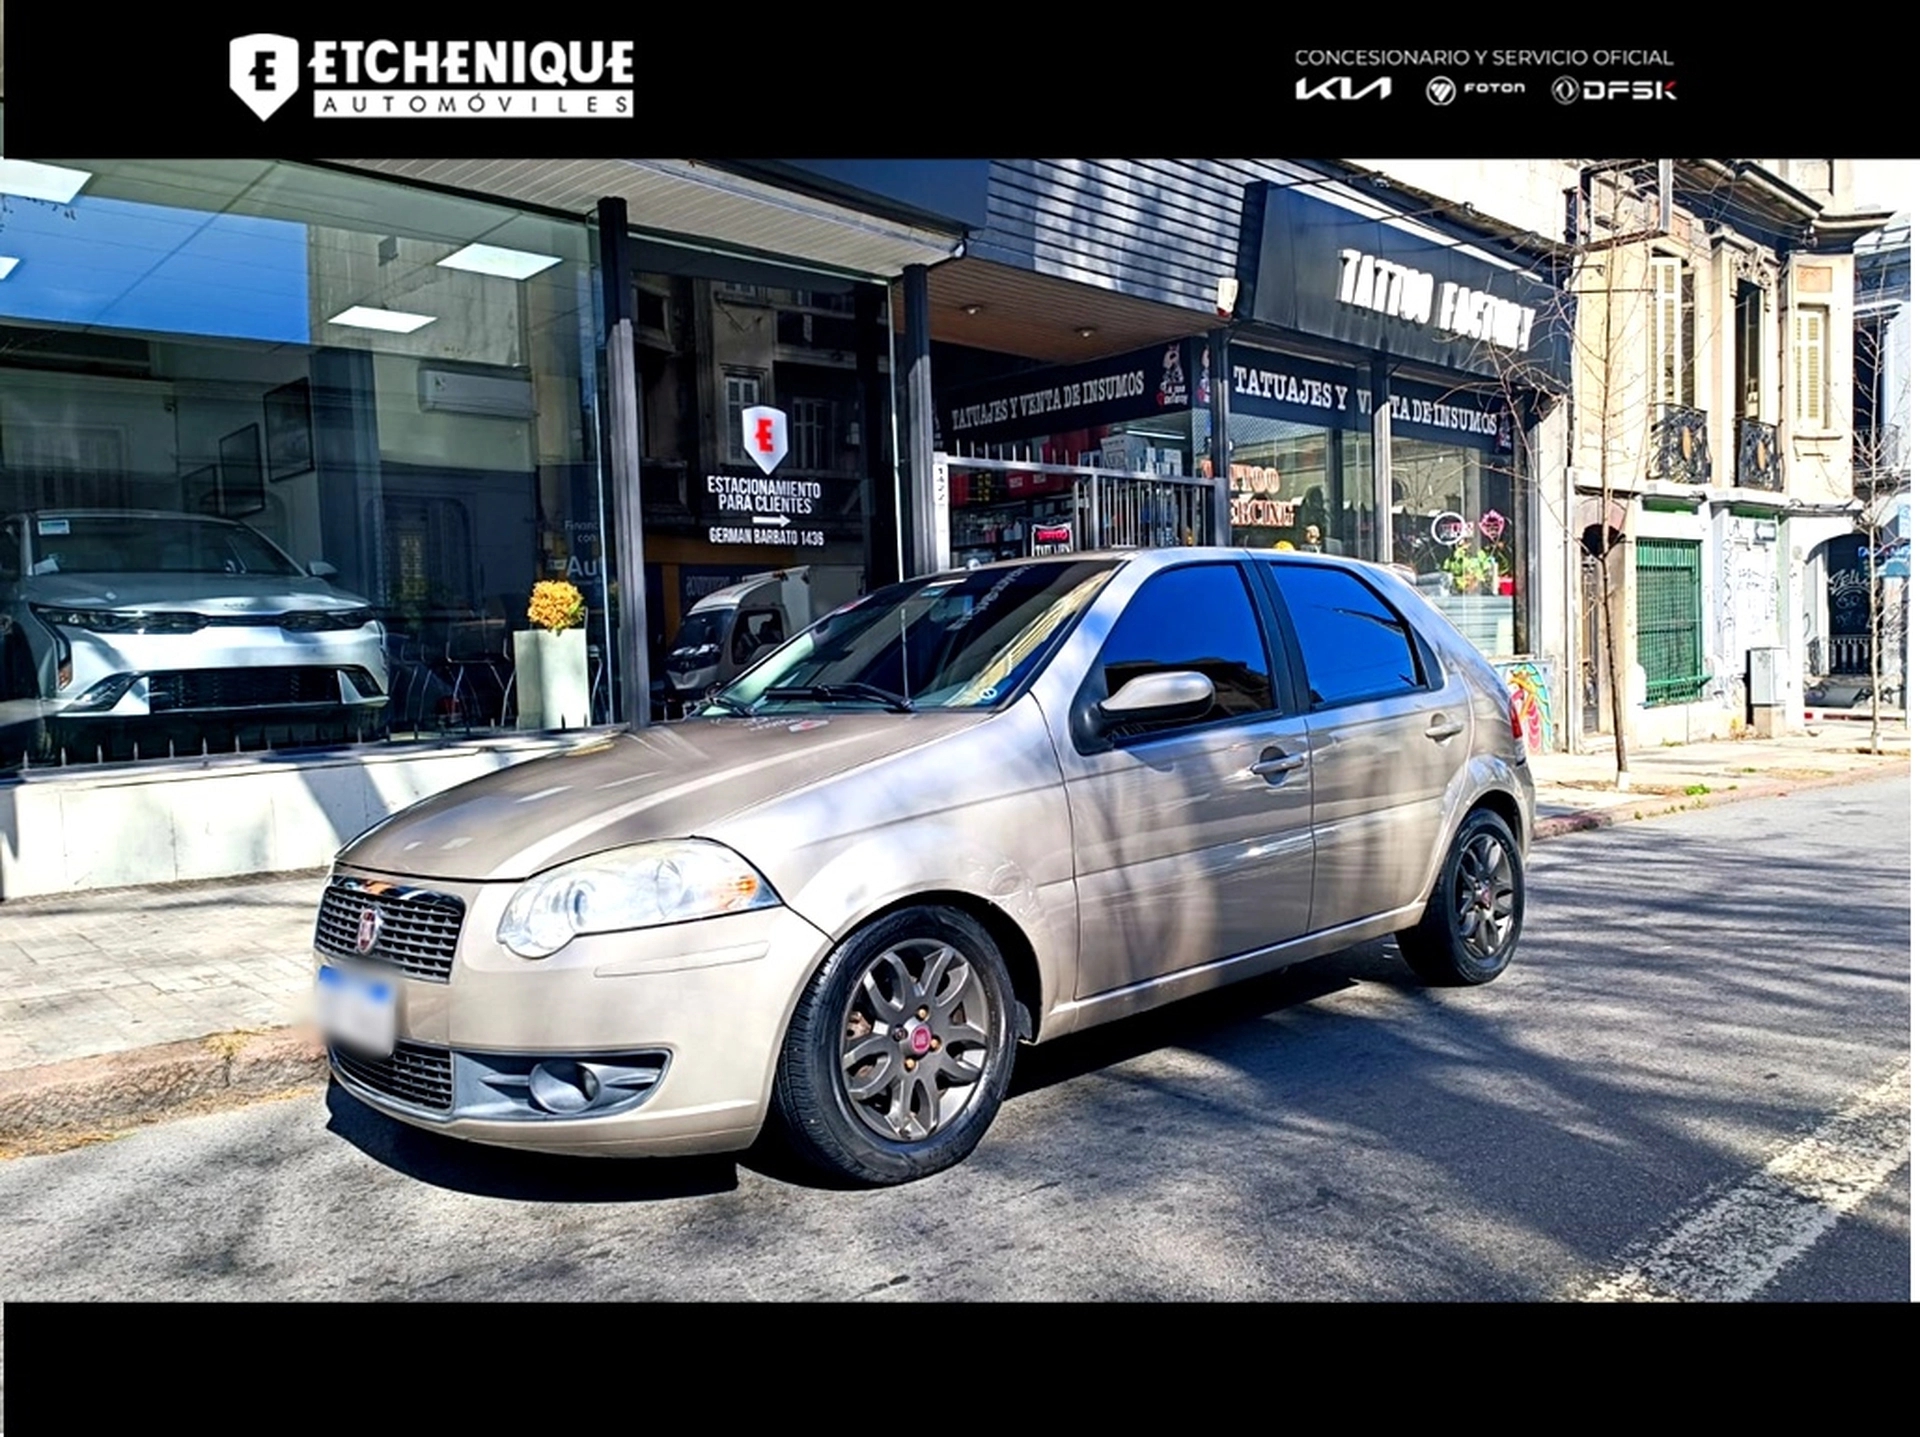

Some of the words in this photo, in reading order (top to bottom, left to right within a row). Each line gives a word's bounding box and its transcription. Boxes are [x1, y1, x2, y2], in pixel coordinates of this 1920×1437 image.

[1336, 248, 1434, 324] TATTOO
[1434, 282, 1536, 352] FACTORY
[952, 398, 1008, 431] TATUAJES
[1009, 396, 1018, 419] Y
[1019, 387, 1062, 417] VENTA
[1063, 383, 1081, 409] DE
[1082, 370, 1144, 405] INSUMOS
[1233, 365, 1332, 409] TATUAJES
[1335, 384, 1348, 411] Y
[1412, 398, 1432, 425] DE
[1433, 403, 1498, 436] INSUMOS
[707, 475, 821, 499] ESTACIONAMIENTO
[718, 493, 753, 511] PARA
[754, 495, 813, 514] CLIENTES
[709, 527, 752, 543] GERMAN
[753, 529, 798, 545] BARBATO
